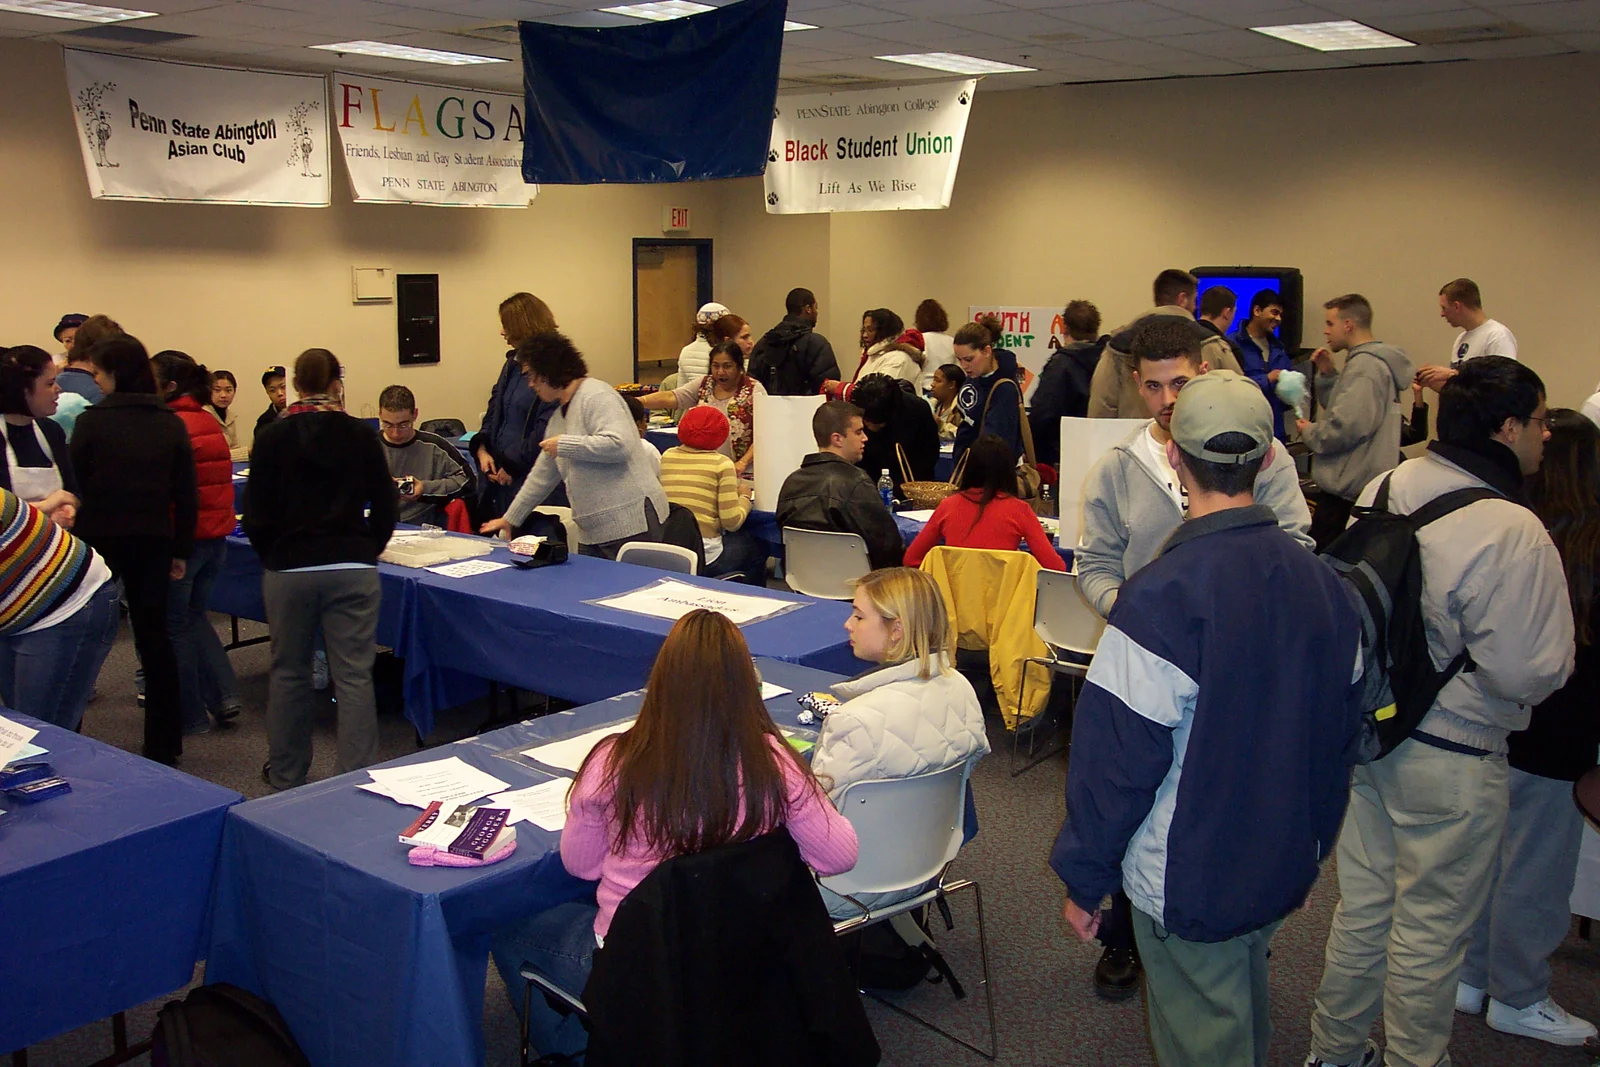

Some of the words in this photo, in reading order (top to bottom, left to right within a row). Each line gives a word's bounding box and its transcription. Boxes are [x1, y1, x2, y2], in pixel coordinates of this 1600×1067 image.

[339, 83, 524, 142] FLAGSA
[857, 103, 900, 117] Abington
[904, 98, 940, 112] College
[129, 98, 167, 135] Penn
[172, 118, 210, 140] State
[214, 117, 277, 145] Abington
[168, 140, 208, 160] Asian
[212, 143, 246, 164] Club
[345, 143, 380, 160] Friends,
[383, 145, 413, 162] Lesbian
[416, 150, 430, 163] and
[434, 151, 450, 168] Gay
[454, 152, 484, 166] Student
[785, 137, 829, 162] Black
[836, 135, 898, 160] Student
[905, 131, 953, 156] Union
[382, 176, 410, 188] PENN
[417, 179, 446, 191] STATE
[451, 181, 498, 193] ABINGTON
[819, 180, 840, 195] Lift
[847, 181, 862, 194] As
[868, 180, 886, 193] We
[892, 179, 917, 192] Rise
[672, 207, 689, 228] EXIT
[974, 311, 1030, 333] SUTH
[471, 815, 497, 847] GEORGE
